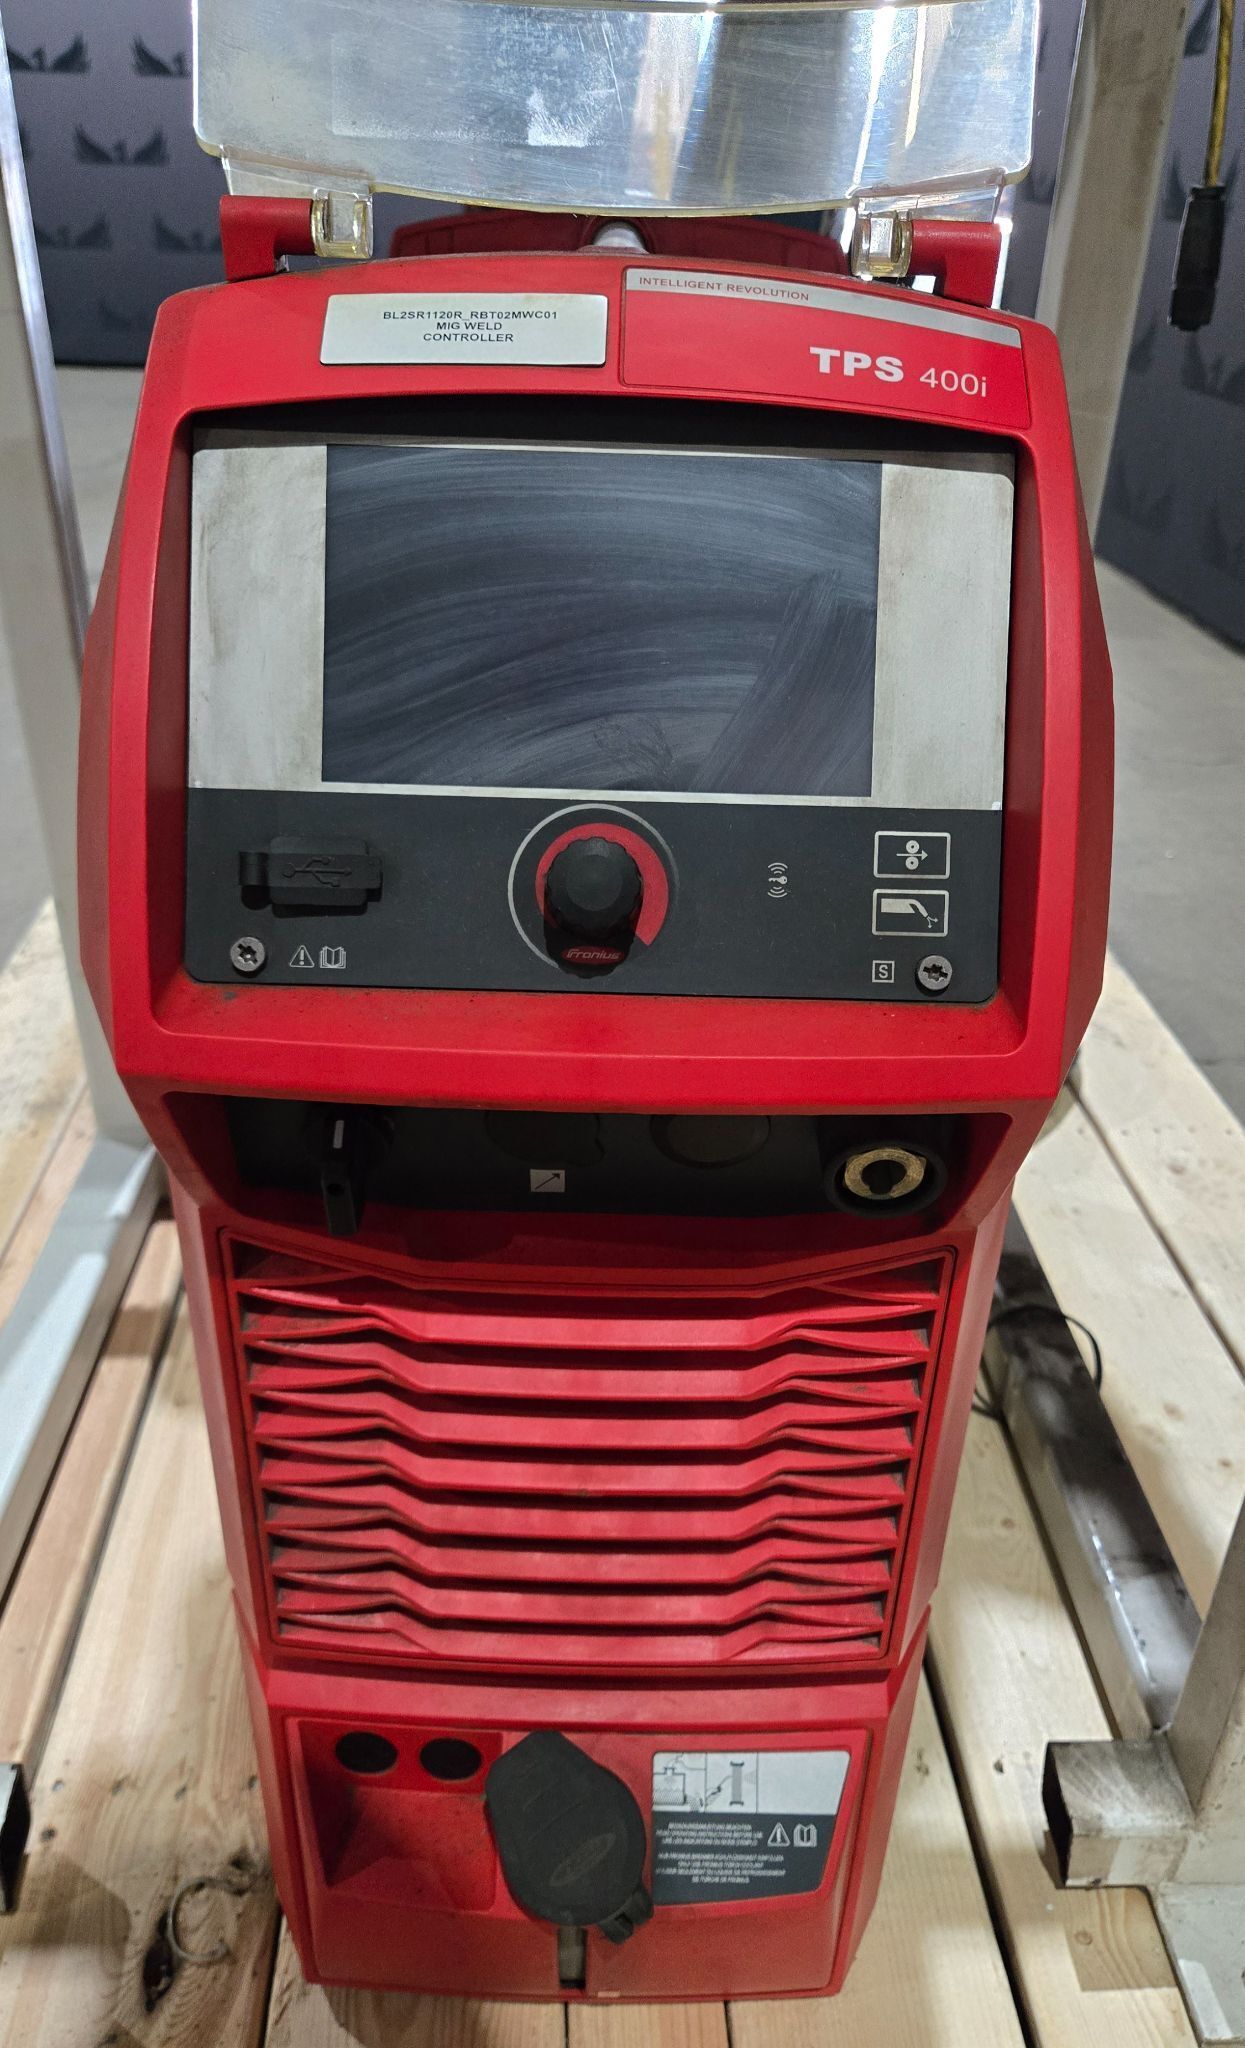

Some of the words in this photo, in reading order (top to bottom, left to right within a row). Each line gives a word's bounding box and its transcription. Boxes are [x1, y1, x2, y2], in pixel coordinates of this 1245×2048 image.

[639, 277, 723, 291] INTELLIGENT
[726, 284, 809, 301] REVOLUTION
[383, 311, 558, 321] BL2SR1120R_RBT02MWC01
[436, 322, 460, 330] MIG
[465, 322, 502, 331] WELD
[423, 333, 514, 342] CONTROLLER
[809, 346, 905, 383] TPS
[919, 367, 987, 398] 400i
